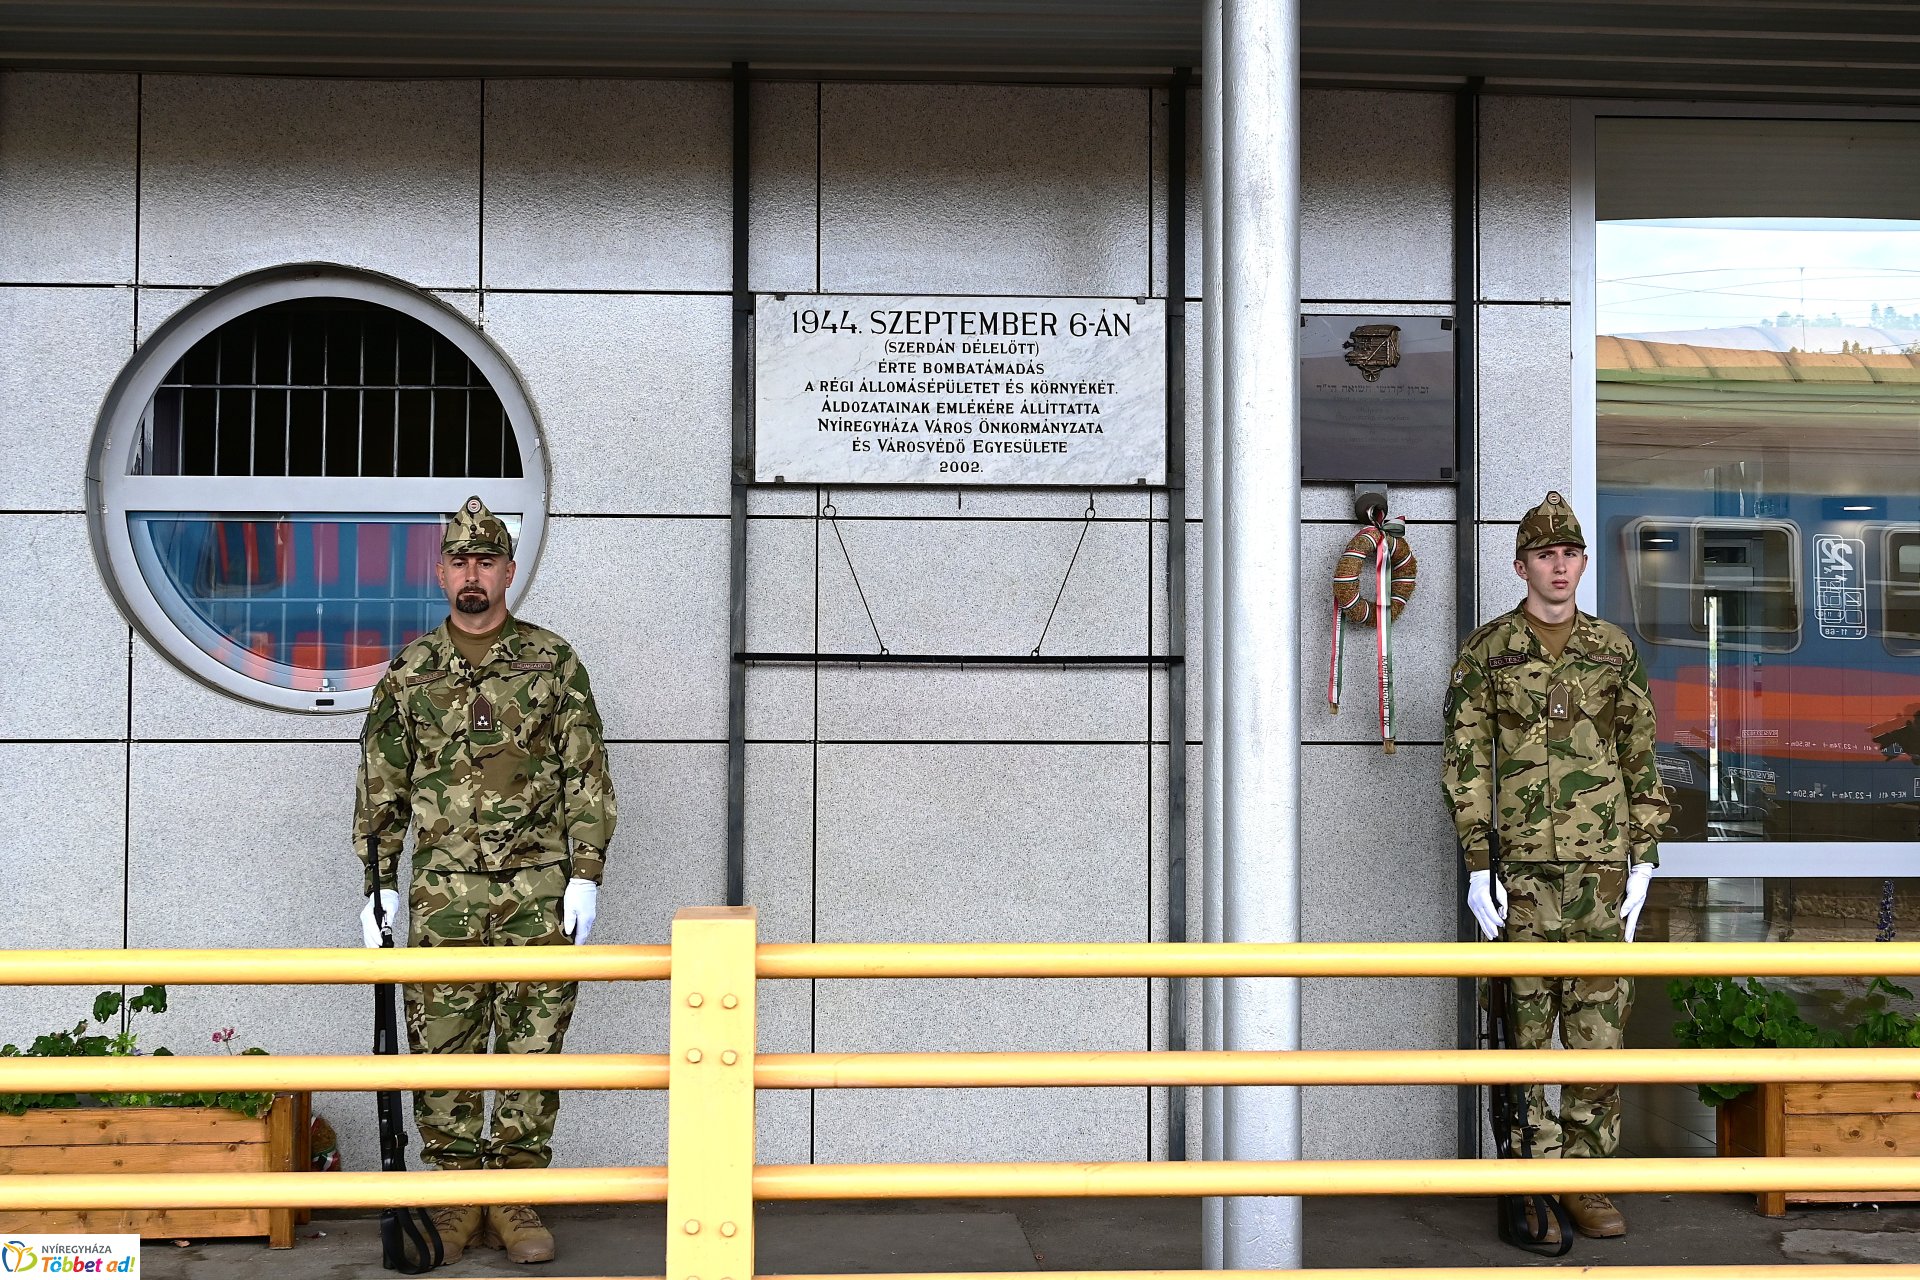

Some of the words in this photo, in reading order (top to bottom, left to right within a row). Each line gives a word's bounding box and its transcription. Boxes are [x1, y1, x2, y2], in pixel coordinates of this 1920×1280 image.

[792, 309, 863, 334] 1944.
[870, 310, 1058, 336] SZEPTEMBER
[1069, 308, 1131, 337] 6-ÁN
[884, 338, 955, 356] (SZERDÁN
[878, 358, 917, 374] ÉRTE
[923, 358, 1045, 375] BOMBATÁMADÁS
[804, 381, 815, 392] A
[819, 377, 854, 392] RÉGI
[858, 377, 1001, 394] ÁLLOMÁSÉPÜLETET
[1005, 379, 1024, 394] ÉS
[1030, 380, 1119, 395] KÖRNYÉKÉT.
[821, 395, 931, 414] ÁLDOZATAINAK
[936, 398, 1014, 414] EMLÉKÉRE
[1020, 399, 1101, 415] ÁLLÍTTATTA
[817, 417, 919, 433] NYÍREGYHÁZA
[924, 418, 973, 434] VÁROS
[978, 418, 1104, 434] ÖNKORMÁNYZATA
[852, 437, 871, 452] ÉS
[973, 439, 1068, 454] EGYESÜLETE
[939, 461, 984, 473] 2002.
